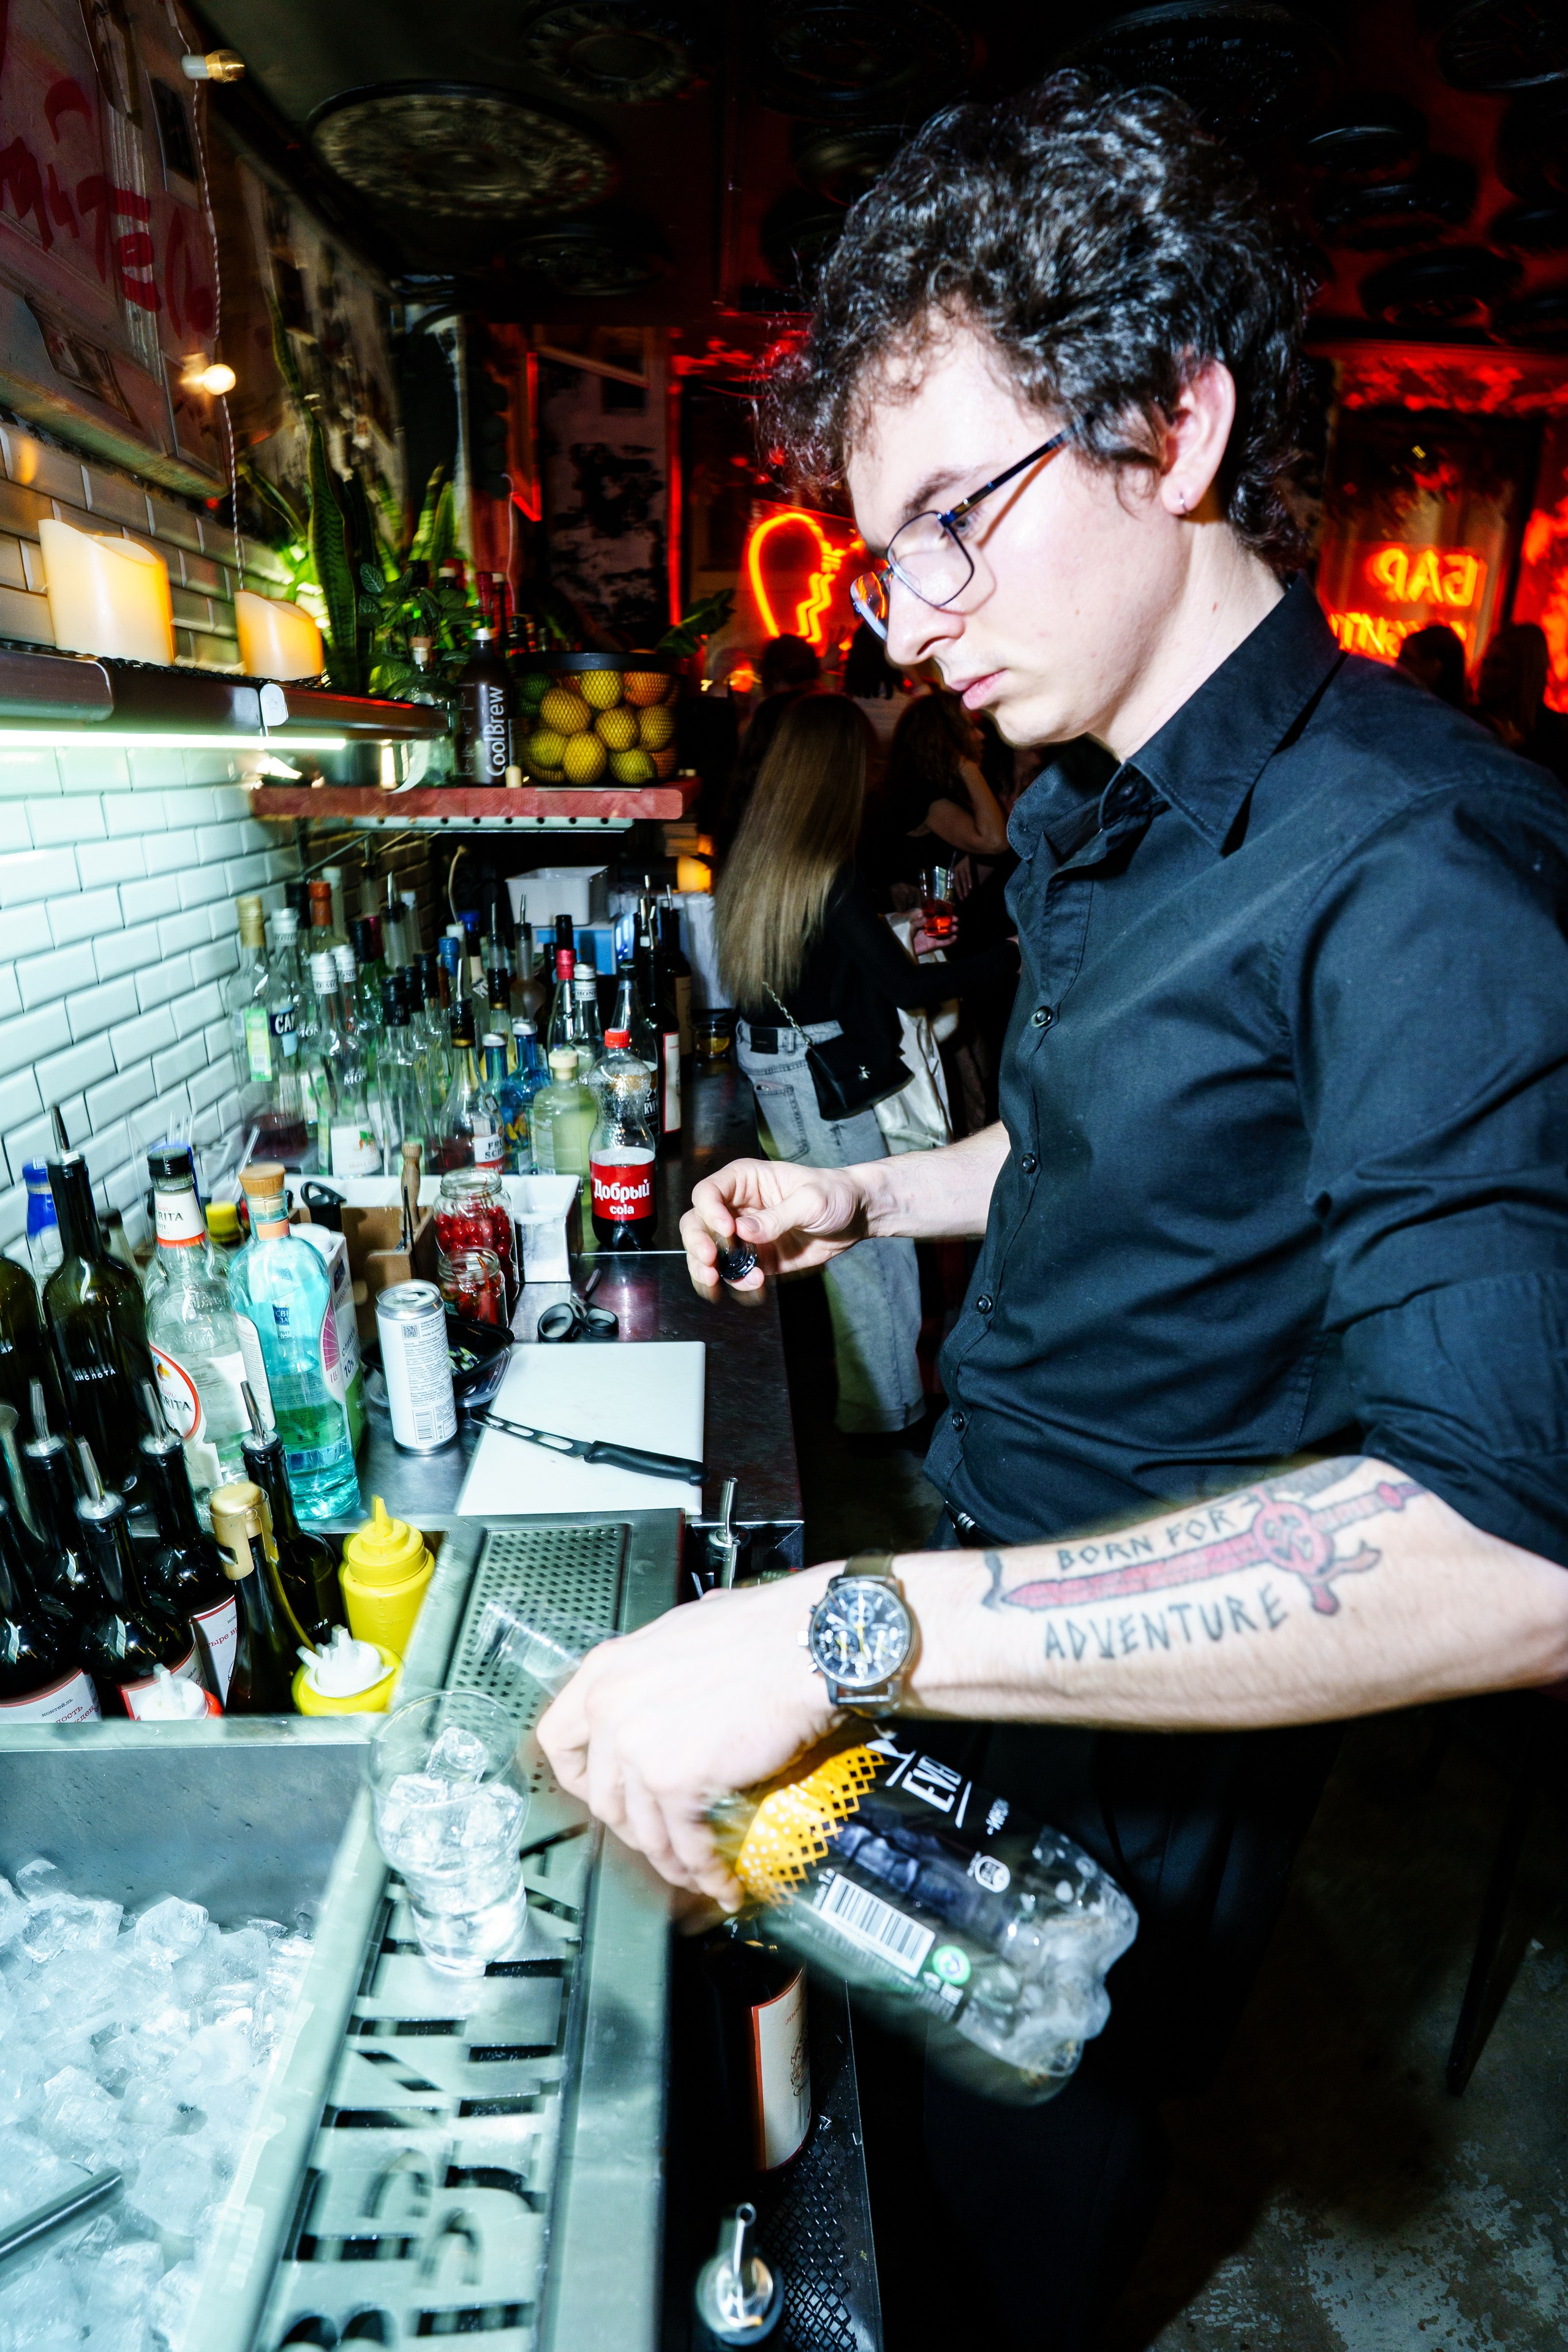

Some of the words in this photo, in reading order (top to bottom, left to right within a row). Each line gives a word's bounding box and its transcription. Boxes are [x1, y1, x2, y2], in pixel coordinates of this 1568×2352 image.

[483, 686, 506, 777] CoolBrew
[594, 1178, 650, 1204] Добрый
[156, 1212, 184, 1221] RITA
[609, 1203, 635, 1215] cola
[1057, 1533, 1153, 1571] BORN
[1166, 1507, 1238, 1547] FOR
[1044, 1581, 1290, 1660] ADVENTURE
[41, 1698, 74, 1717] коктейль
